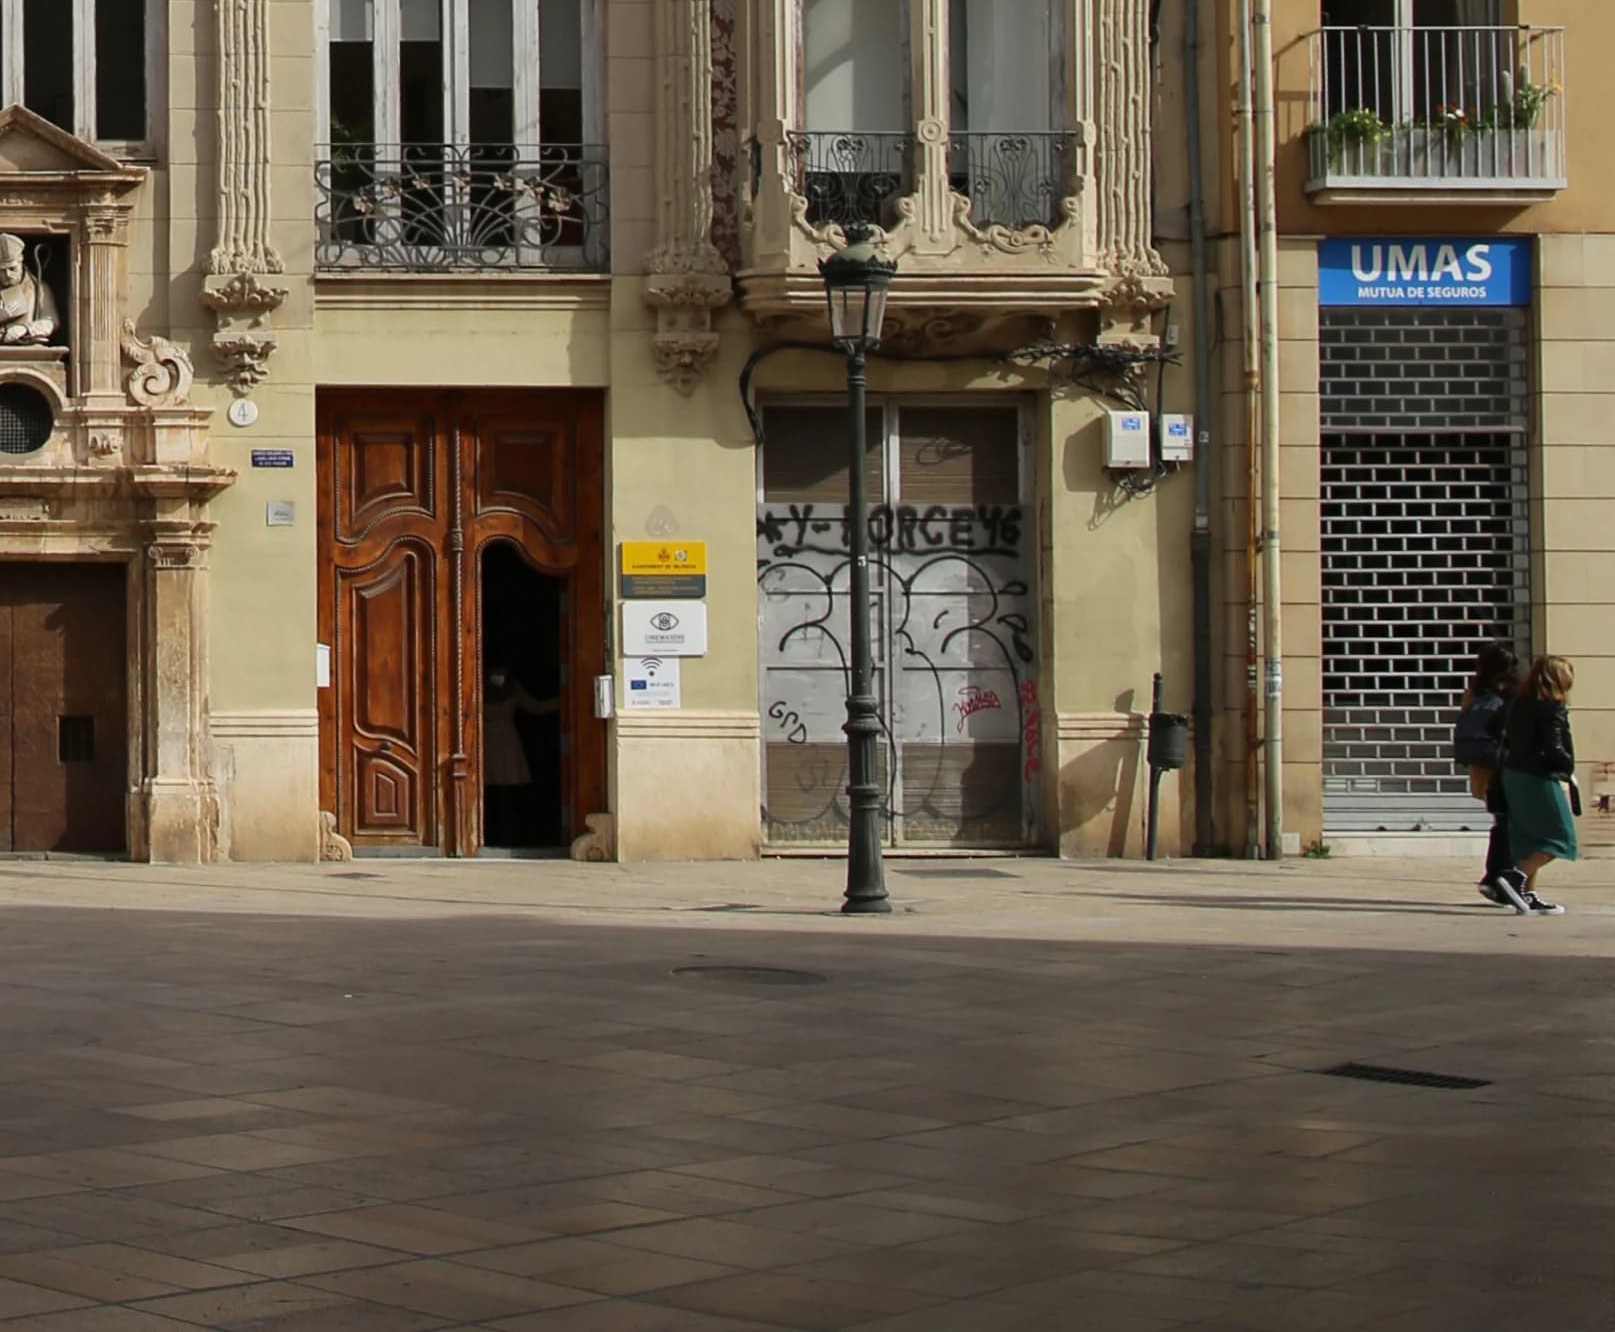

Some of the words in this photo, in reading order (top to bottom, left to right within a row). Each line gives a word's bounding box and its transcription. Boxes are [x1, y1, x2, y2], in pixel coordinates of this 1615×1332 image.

[1351, 243, 1493, 283] UMAS
[1358, 286, 1405, 299] MUTUA
[1407, 286, 1425, 299] DE
[1427, 286, 1487, 299] SEGUROS
[237, 401, 249, 422] 4
